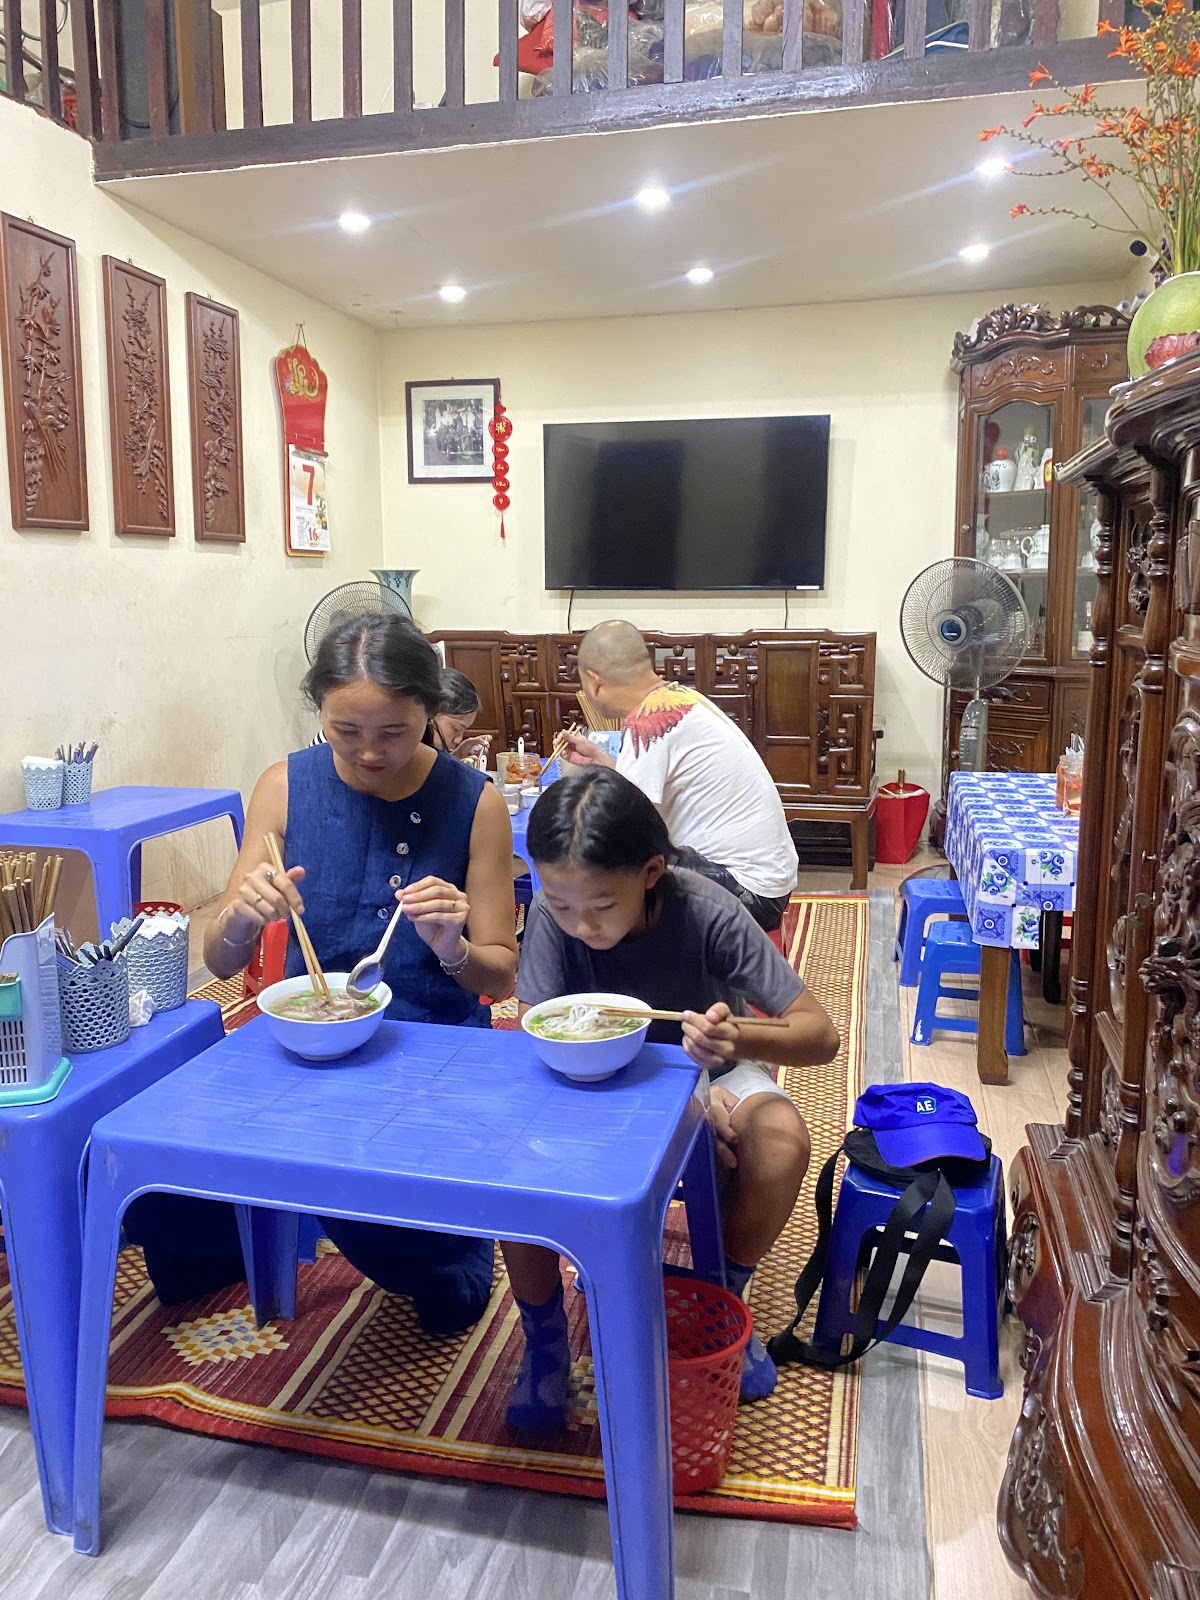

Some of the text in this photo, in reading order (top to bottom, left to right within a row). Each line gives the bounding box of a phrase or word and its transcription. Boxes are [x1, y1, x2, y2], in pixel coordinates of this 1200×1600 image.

[302, 464, 315, 506] 7
[308, 527, 319, 542] 16
[916, 1100, 934, 1113] AE
